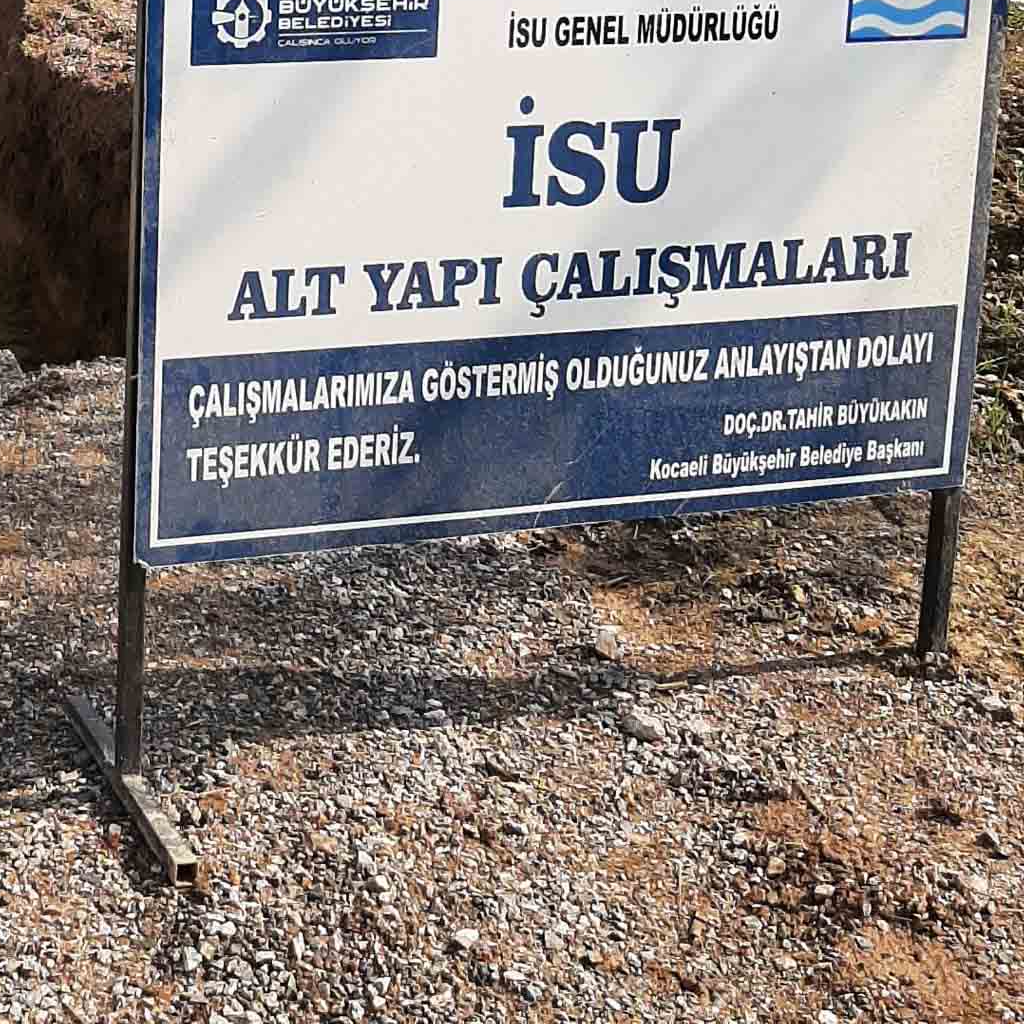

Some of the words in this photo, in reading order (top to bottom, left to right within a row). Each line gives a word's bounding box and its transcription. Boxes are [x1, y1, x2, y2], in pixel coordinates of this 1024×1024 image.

[278, 14, 392, 31] BELEDİYESİ
[508, 11, 547, 49] İSU
[554, 15, 630, 47] GENEL
[637, 3, 780, 45] MÜDÜRLÜĞÜ
[503, 95, 682, 208] İSU
[227, 266, 346, 321] ALT
[363, 257, 503, 312] YAPI
[521, 231, 913, 318] ÇALIŞMALARI
[187, 370, 415, 428] ÇALIŞMALARIMIZA
[422, 353, 560, 401] GÖSTERMİŞ
[566, 346, 708, 391] OLDUĞUNUZ
[714, 339, 851, 383] ANLAYIŞTAN
[857, 332, 935, 366] DOLAYI
[837, 397, 929, 427] BÜYÜKAKIN
[186, 433, 321, 489] TEŞEKKÜR
[327, 424, 421, 471] EDERİZ.
[649, 456, 708, 481] Kocaeli
[712, 447, 797, 477] Büyükşehir
[799, 443, 864, 470] Belediye
[866, 436, 925, 465] Başkanı
